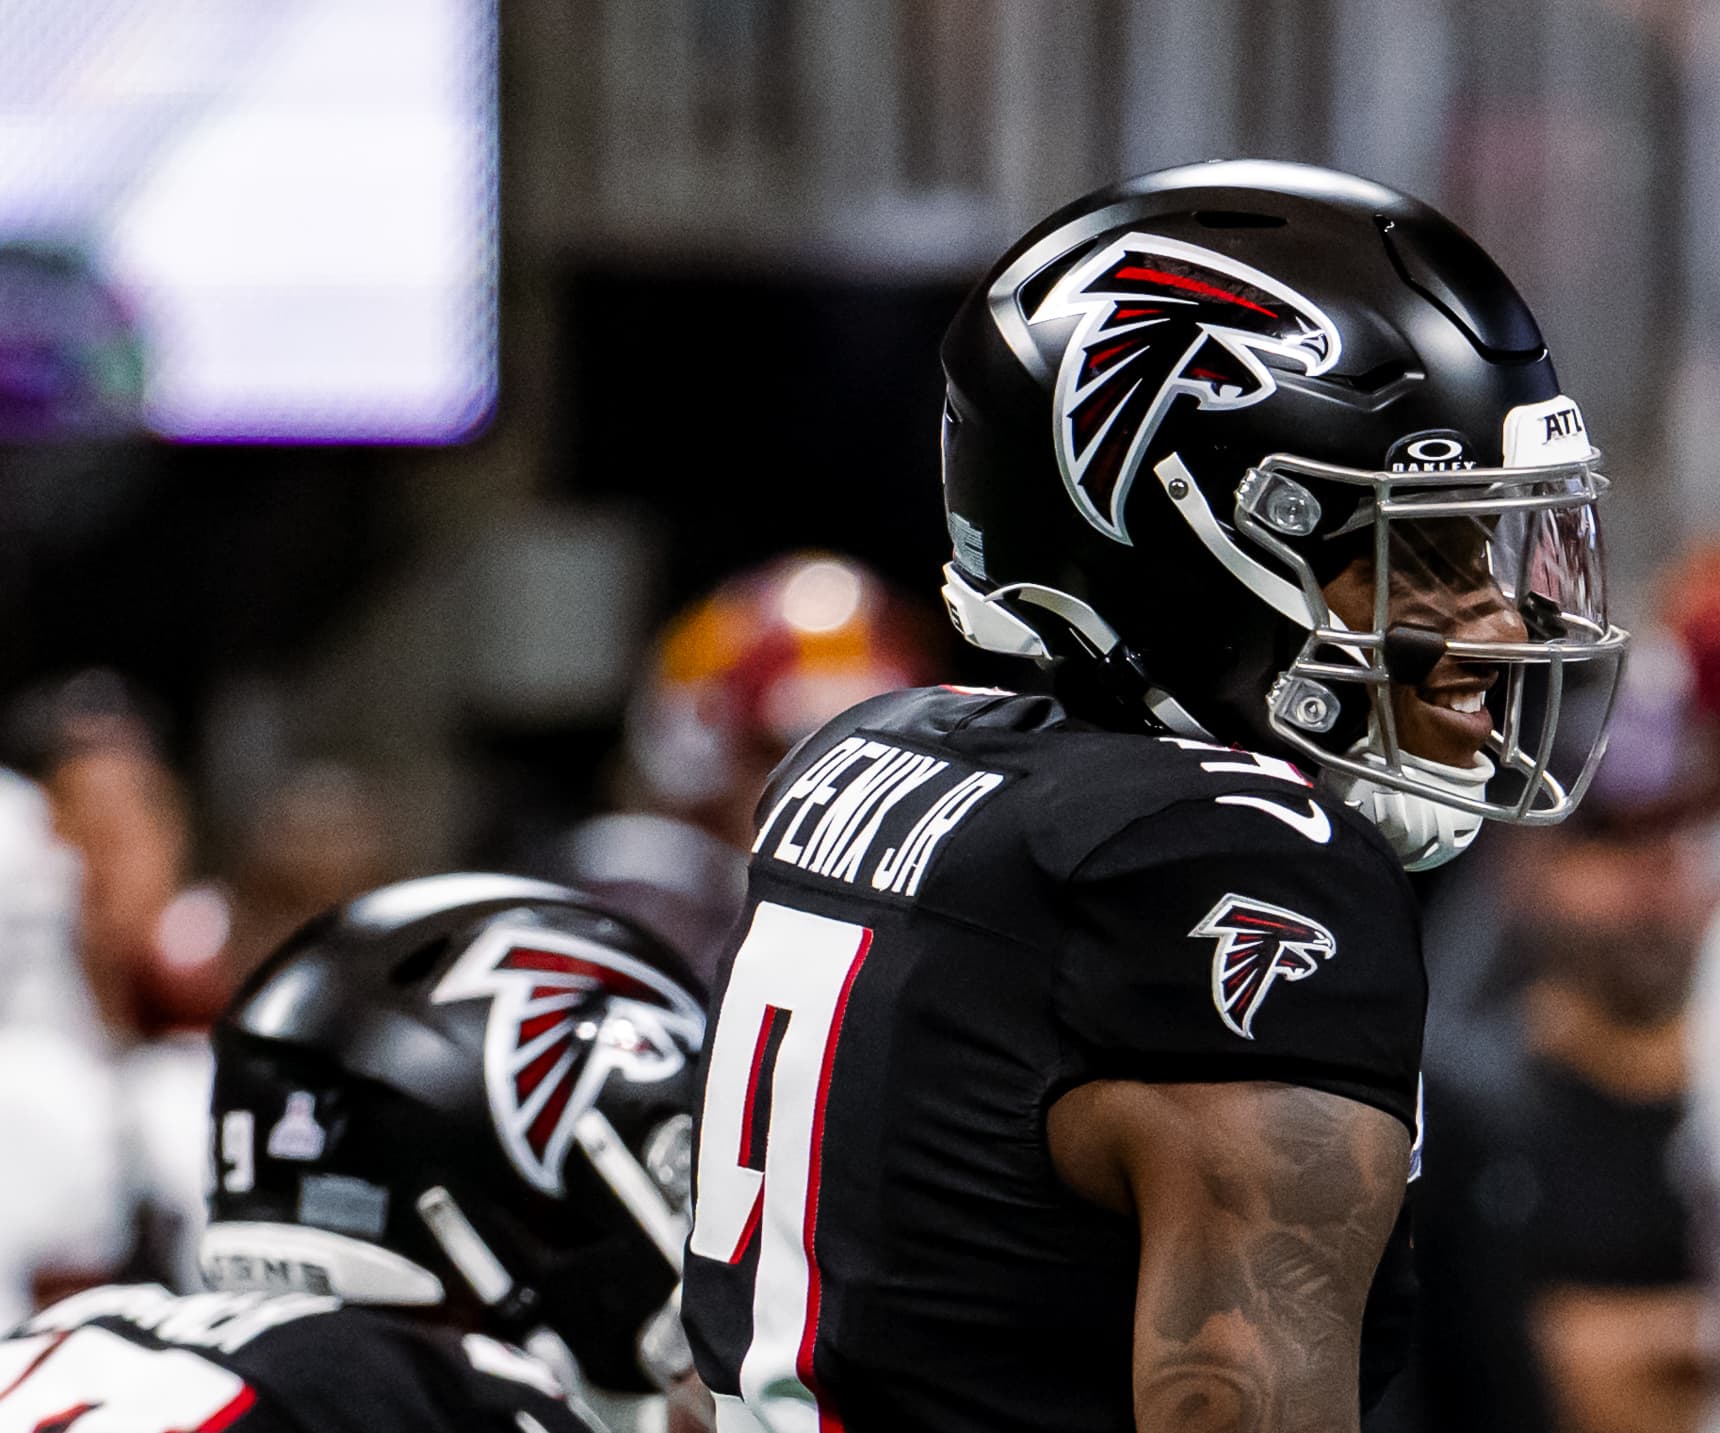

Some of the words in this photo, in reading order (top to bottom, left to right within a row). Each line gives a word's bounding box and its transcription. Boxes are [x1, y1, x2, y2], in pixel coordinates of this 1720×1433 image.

[1392, 461, 1476, 472] OAKLEY
[751, 736, 950, 884] PENIX
[871, 771, 1004, 897] JR
